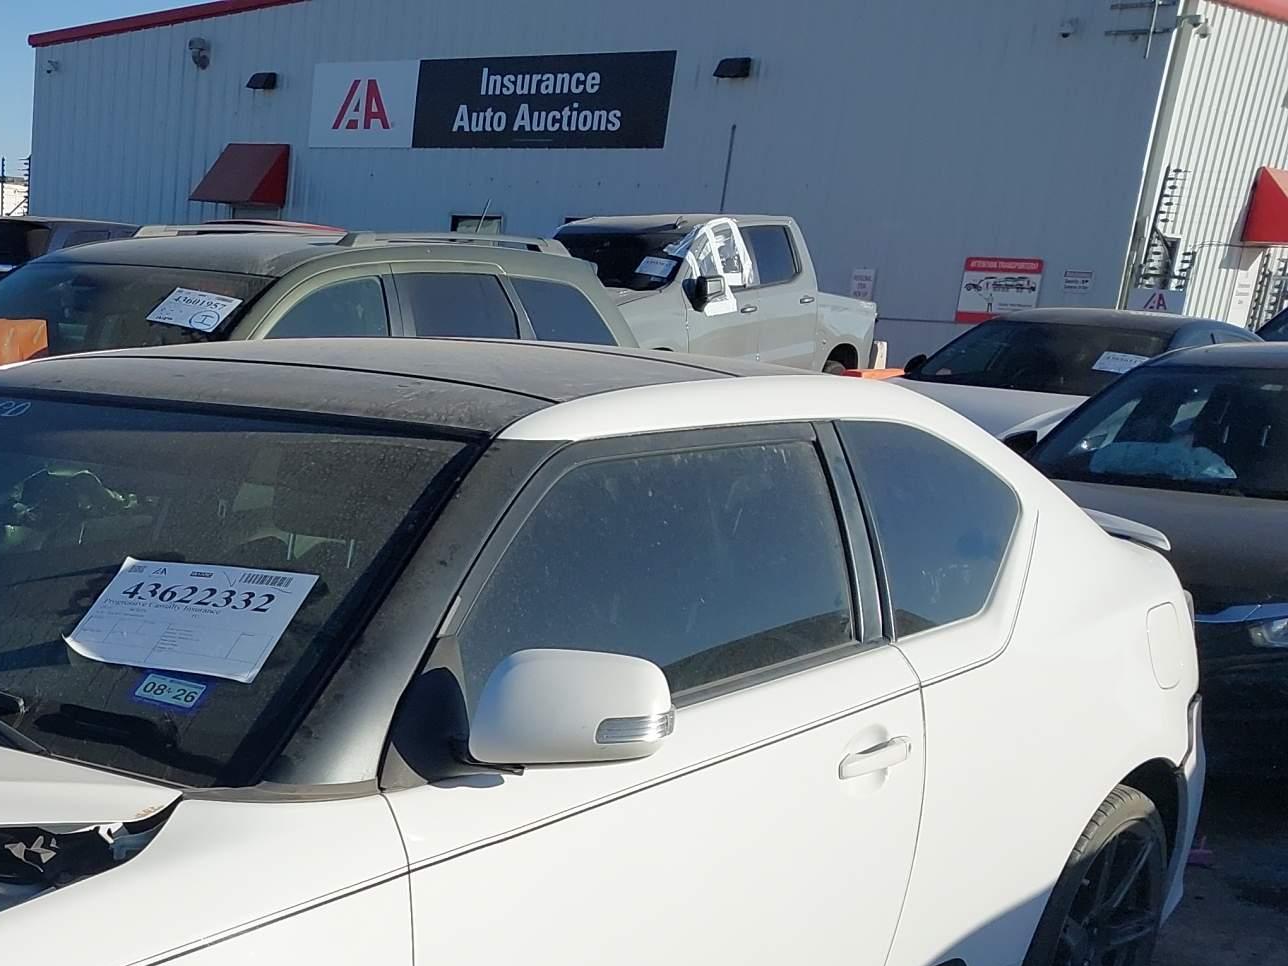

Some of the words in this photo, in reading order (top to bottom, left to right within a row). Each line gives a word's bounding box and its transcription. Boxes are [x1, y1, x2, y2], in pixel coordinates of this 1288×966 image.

[479, 67, 601, 96] Insurance
[451, 104, 506, 133] Auto
[513, 102, 622, 132] Auctions
[122, 580, 276, 614] 43622332
